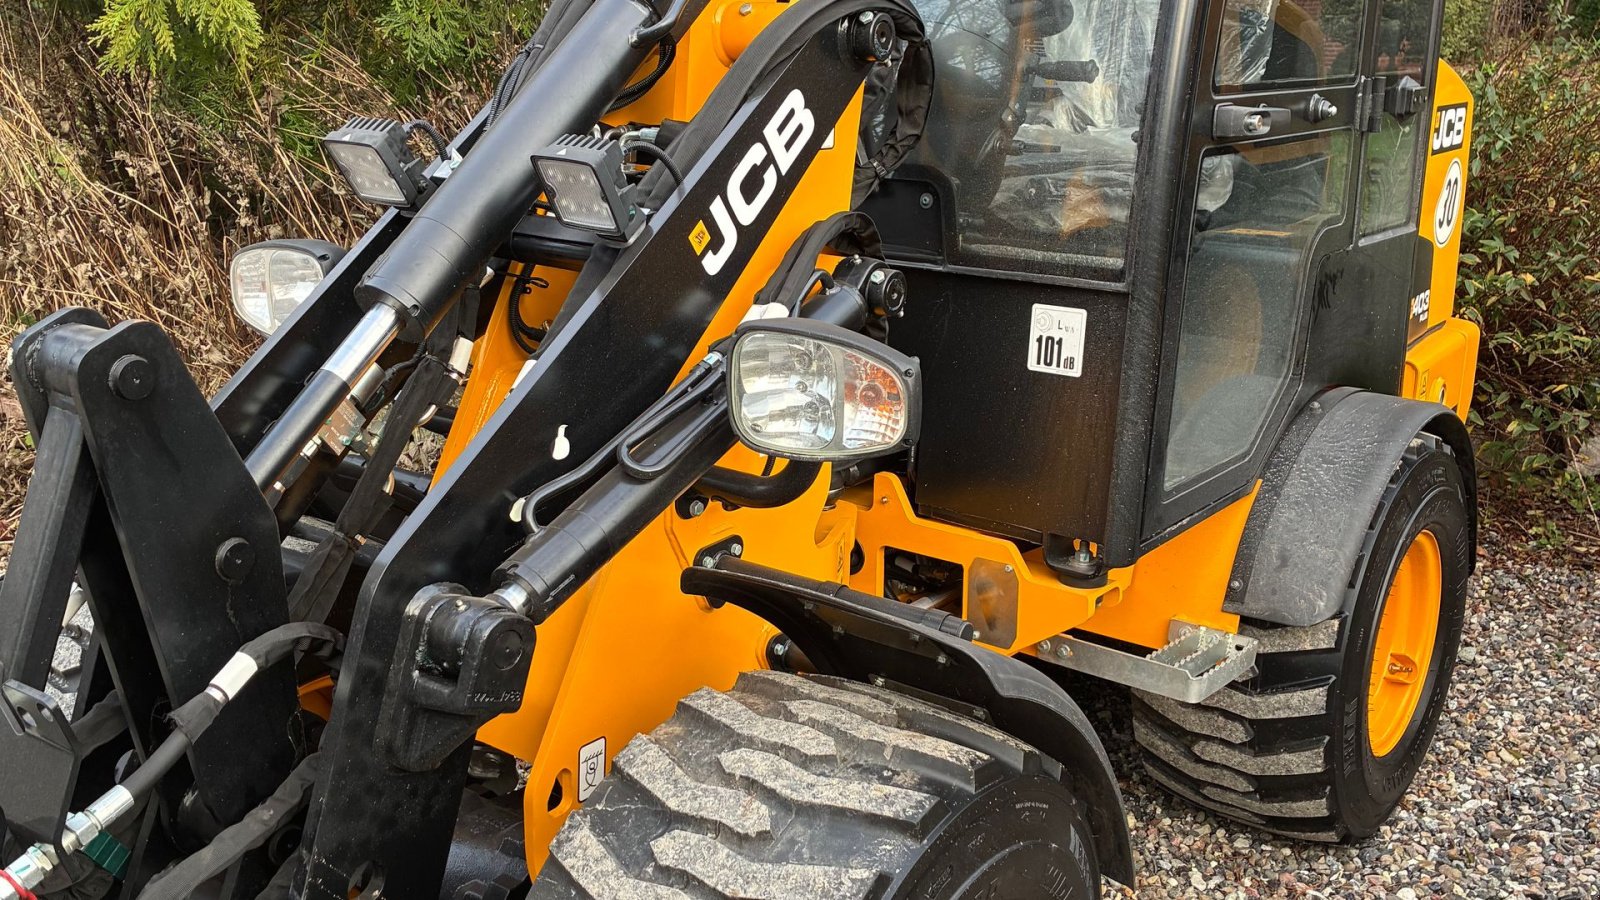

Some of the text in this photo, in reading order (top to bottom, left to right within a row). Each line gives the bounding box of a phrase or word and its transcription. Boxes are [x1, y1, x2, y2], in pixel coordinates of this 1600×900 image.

[1432, 107, 1466, 150] JCB
[701, 88, 815, 276] JCB
[1438, 177, 1458, 229] 30
[1036, 334, 1075, 370] 101 dB
